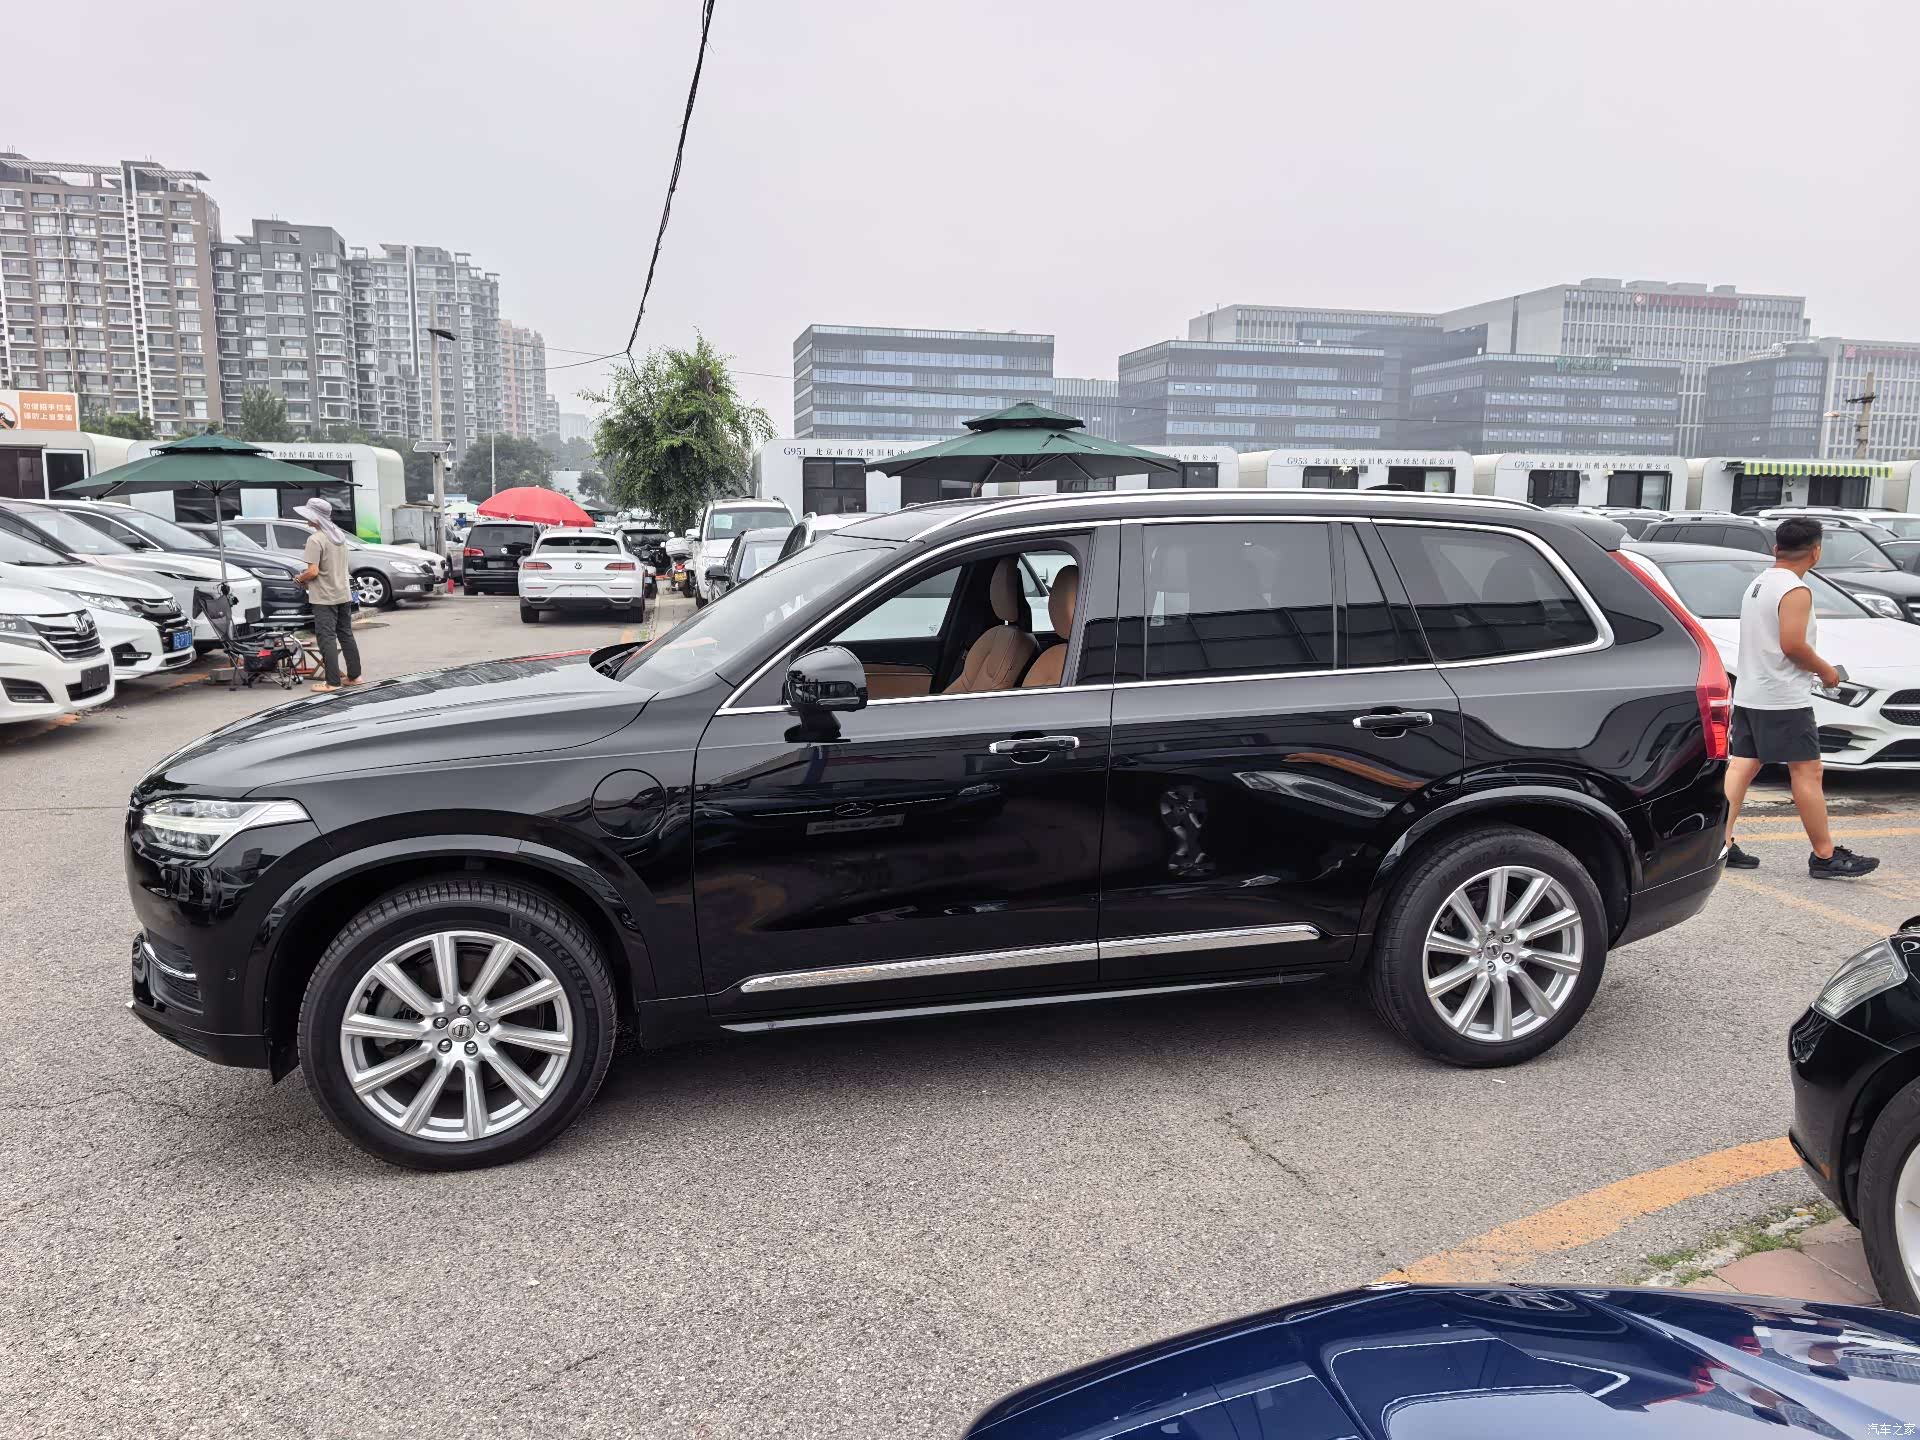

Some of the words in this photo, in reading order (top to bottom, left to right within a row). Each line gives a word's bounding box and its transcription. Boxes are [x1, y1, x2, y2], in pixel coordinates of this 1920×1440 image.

[783, 447, 806, 456] G951
[1287, 456, 1308, 465] G953
[1514, 461, 1534, 469] G955
